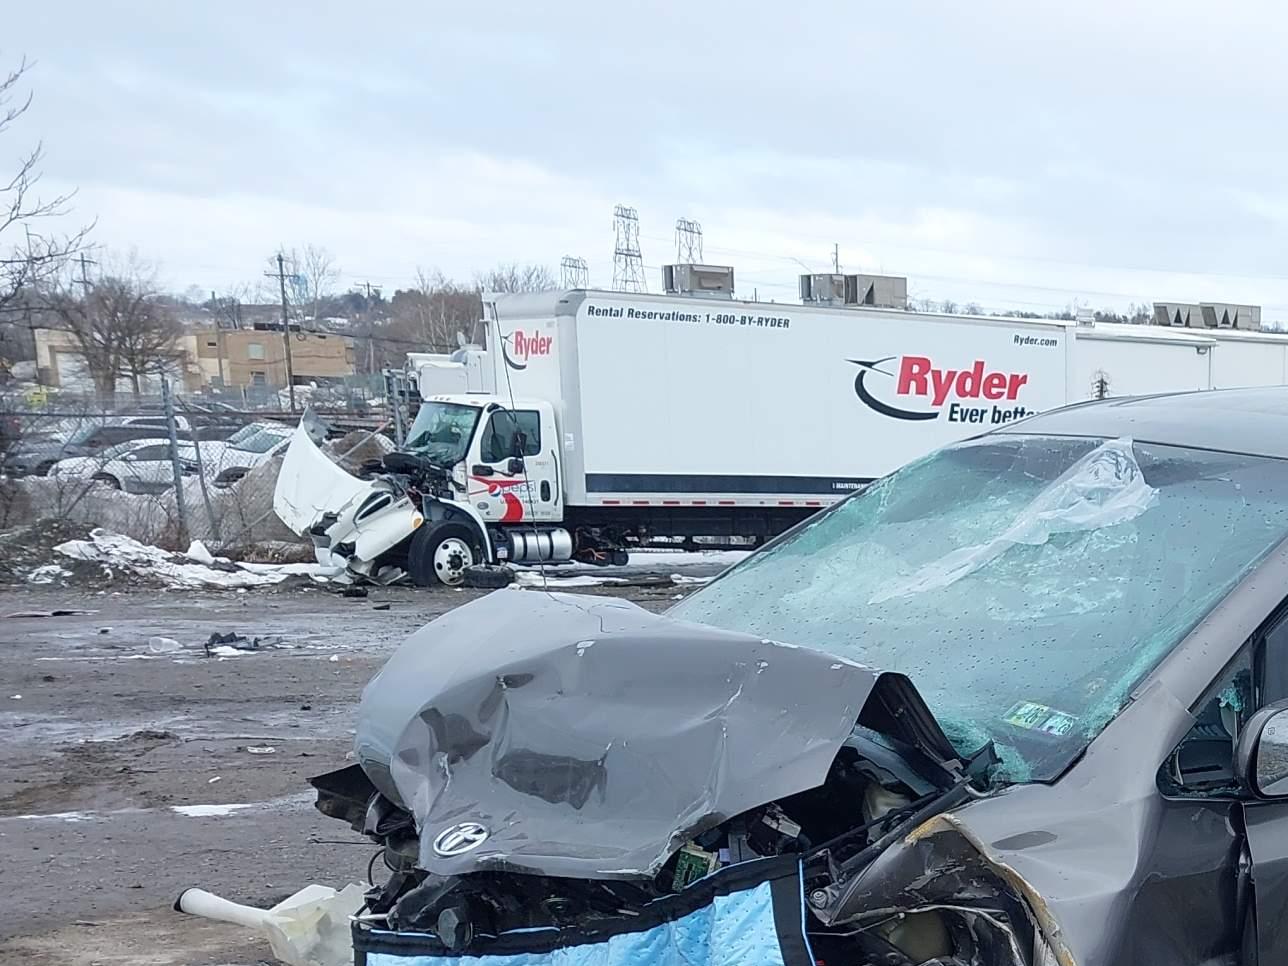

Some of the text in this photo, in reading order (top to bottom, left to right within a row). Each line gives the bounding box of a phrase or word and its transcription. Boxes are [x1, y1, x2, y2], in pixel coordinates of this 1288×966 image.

[587, 305, 790, 329] Rental Reservations: 1-800-BY-RYDER
[514, 330, 553, 361] Ryder
[1013, 334, 1058, 347] Ryder.com
[897, 356, 1028, 406] Ryder
[948, 403, 988, 423] Ever
